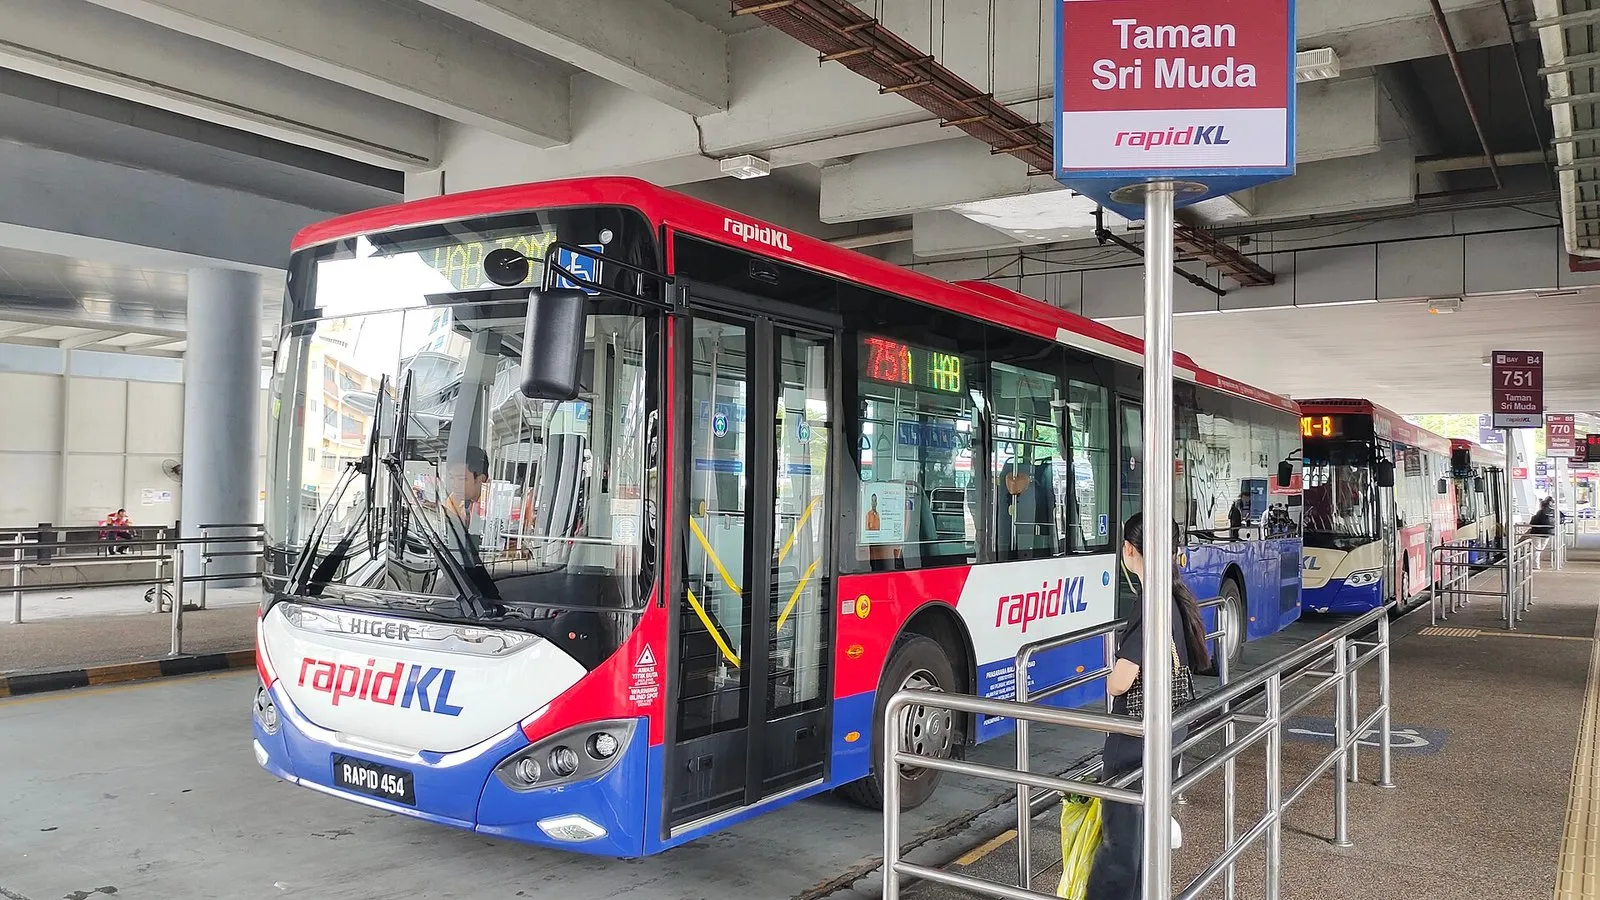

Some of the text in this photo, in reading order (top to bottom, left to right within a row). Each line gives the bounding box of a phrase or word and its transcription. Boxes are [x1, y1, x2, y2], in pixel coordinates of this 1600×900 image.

[1112, 18, 1236, 49] Taman
[1091, 57, 1256, 90] Sri Muda
[1114, 125, 1231, 151] rapidKL
[723, 217, 793, 252] rapidKL
[1527, 356, 1540, 364] B4
[1502, 371, 1532, 386] 751
[1501, 402, 1536, 410] Sri Muda
[1505, 393, 1531, 401] Taman
[1551, 424, 1570, 434] 770
[995, 576, 1088, 633] rapidKL
[351, 617, 411, 641] HIGER
[298, 657, 464, 717] rapidKL
[343, 763, 405, 797] RAPID 454
